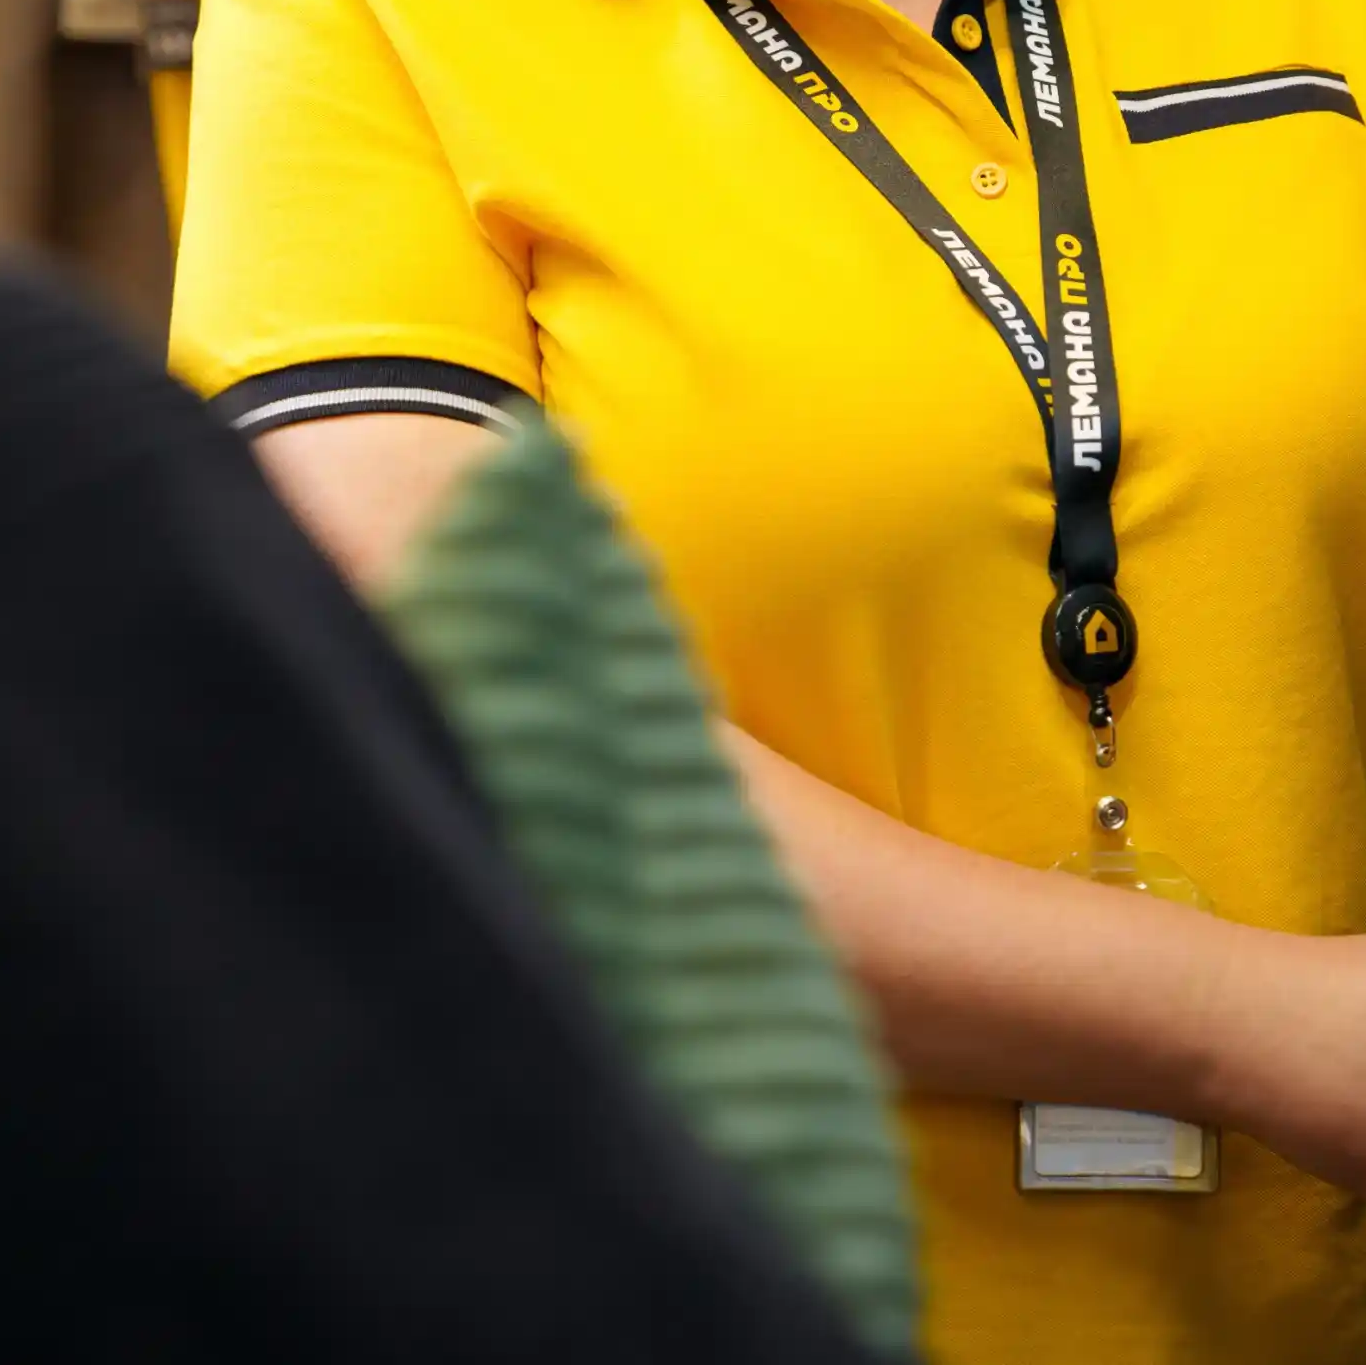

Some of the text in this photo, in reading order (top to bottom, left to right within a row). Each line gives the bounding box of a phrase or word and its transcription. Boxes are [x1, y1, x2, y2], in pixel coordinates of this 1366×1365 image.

[793, 71, 859, 133] ПРО
[931, 227, 1045, 370] ЛЕМАНА
[1055, 233, 1103, 473] ЛЕМАНА ПРО
